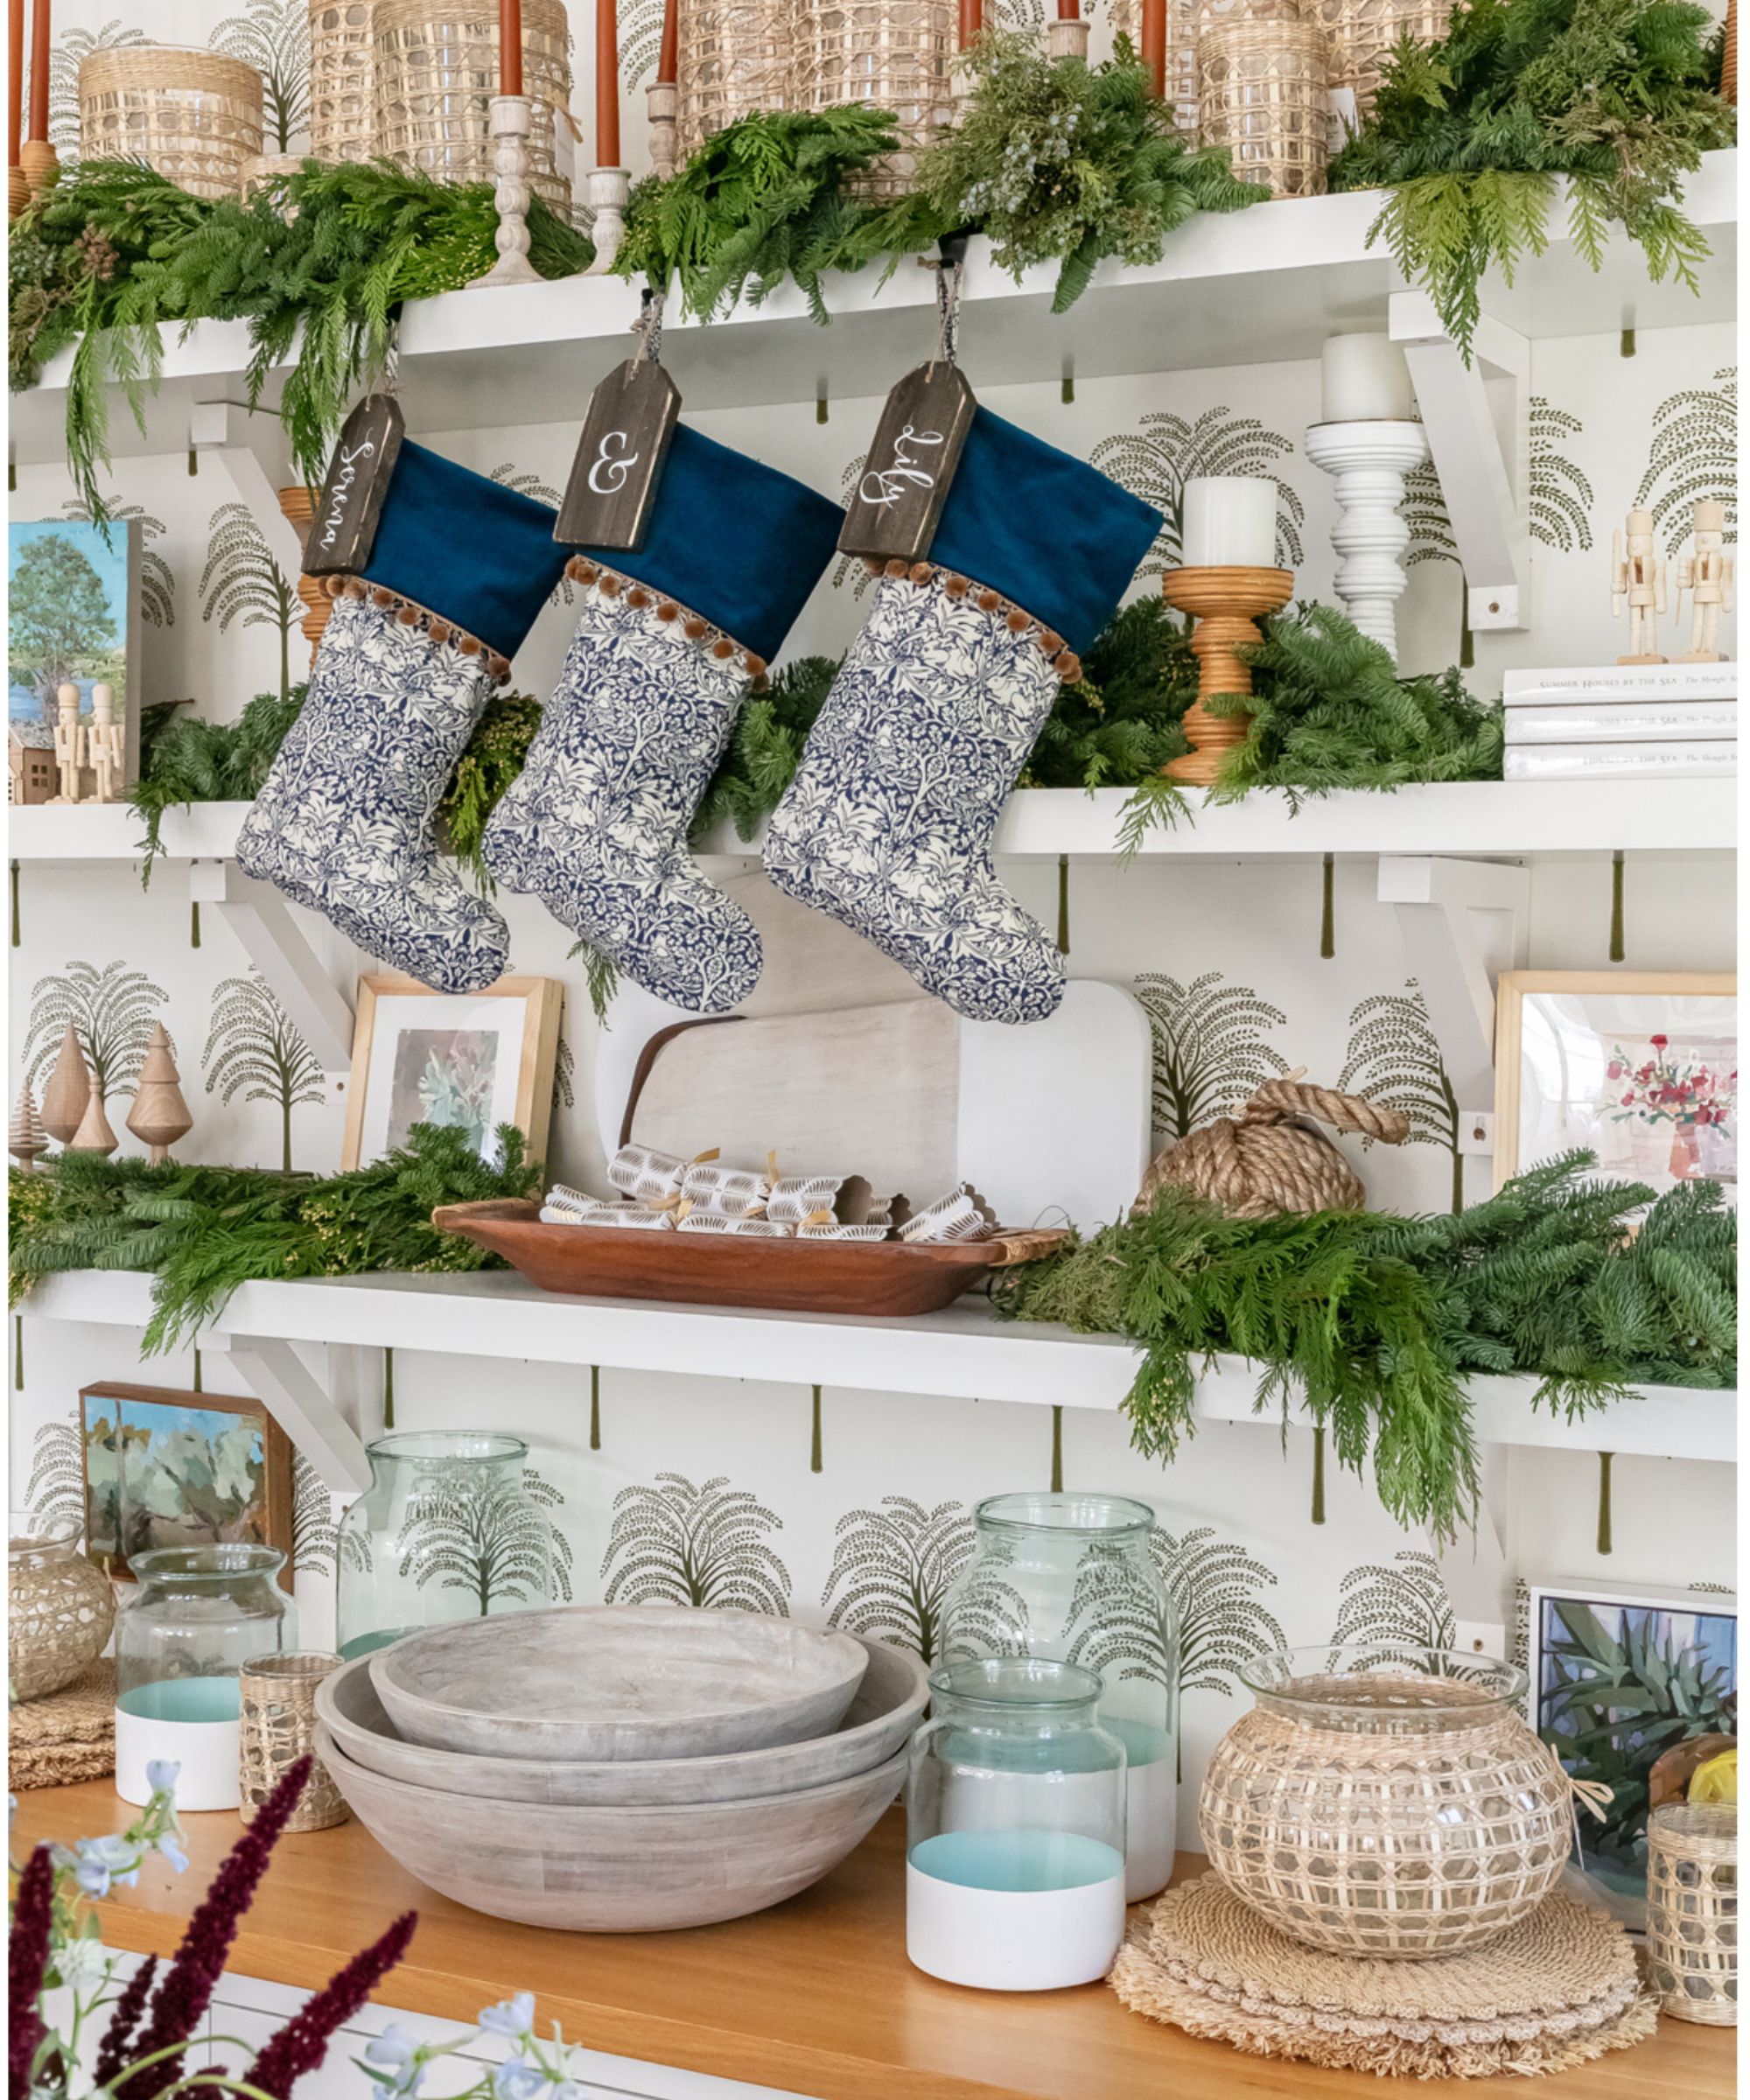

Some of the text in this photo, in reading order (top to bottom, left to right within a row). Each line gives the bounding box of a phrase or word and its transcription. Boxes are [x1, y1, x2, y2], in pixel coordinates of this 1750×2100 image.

[319, 427, 374, 551] Serena
[588, 430, 639, 494] &
[858, 424, 944, 509] Lily
[1540, 680, 1578, 689] SUMMER
[1583, 679, 1620, 689] HOUSES
[1639, 677, 1656, 686] THE
[1659, 677, 1677, 686] SEA
